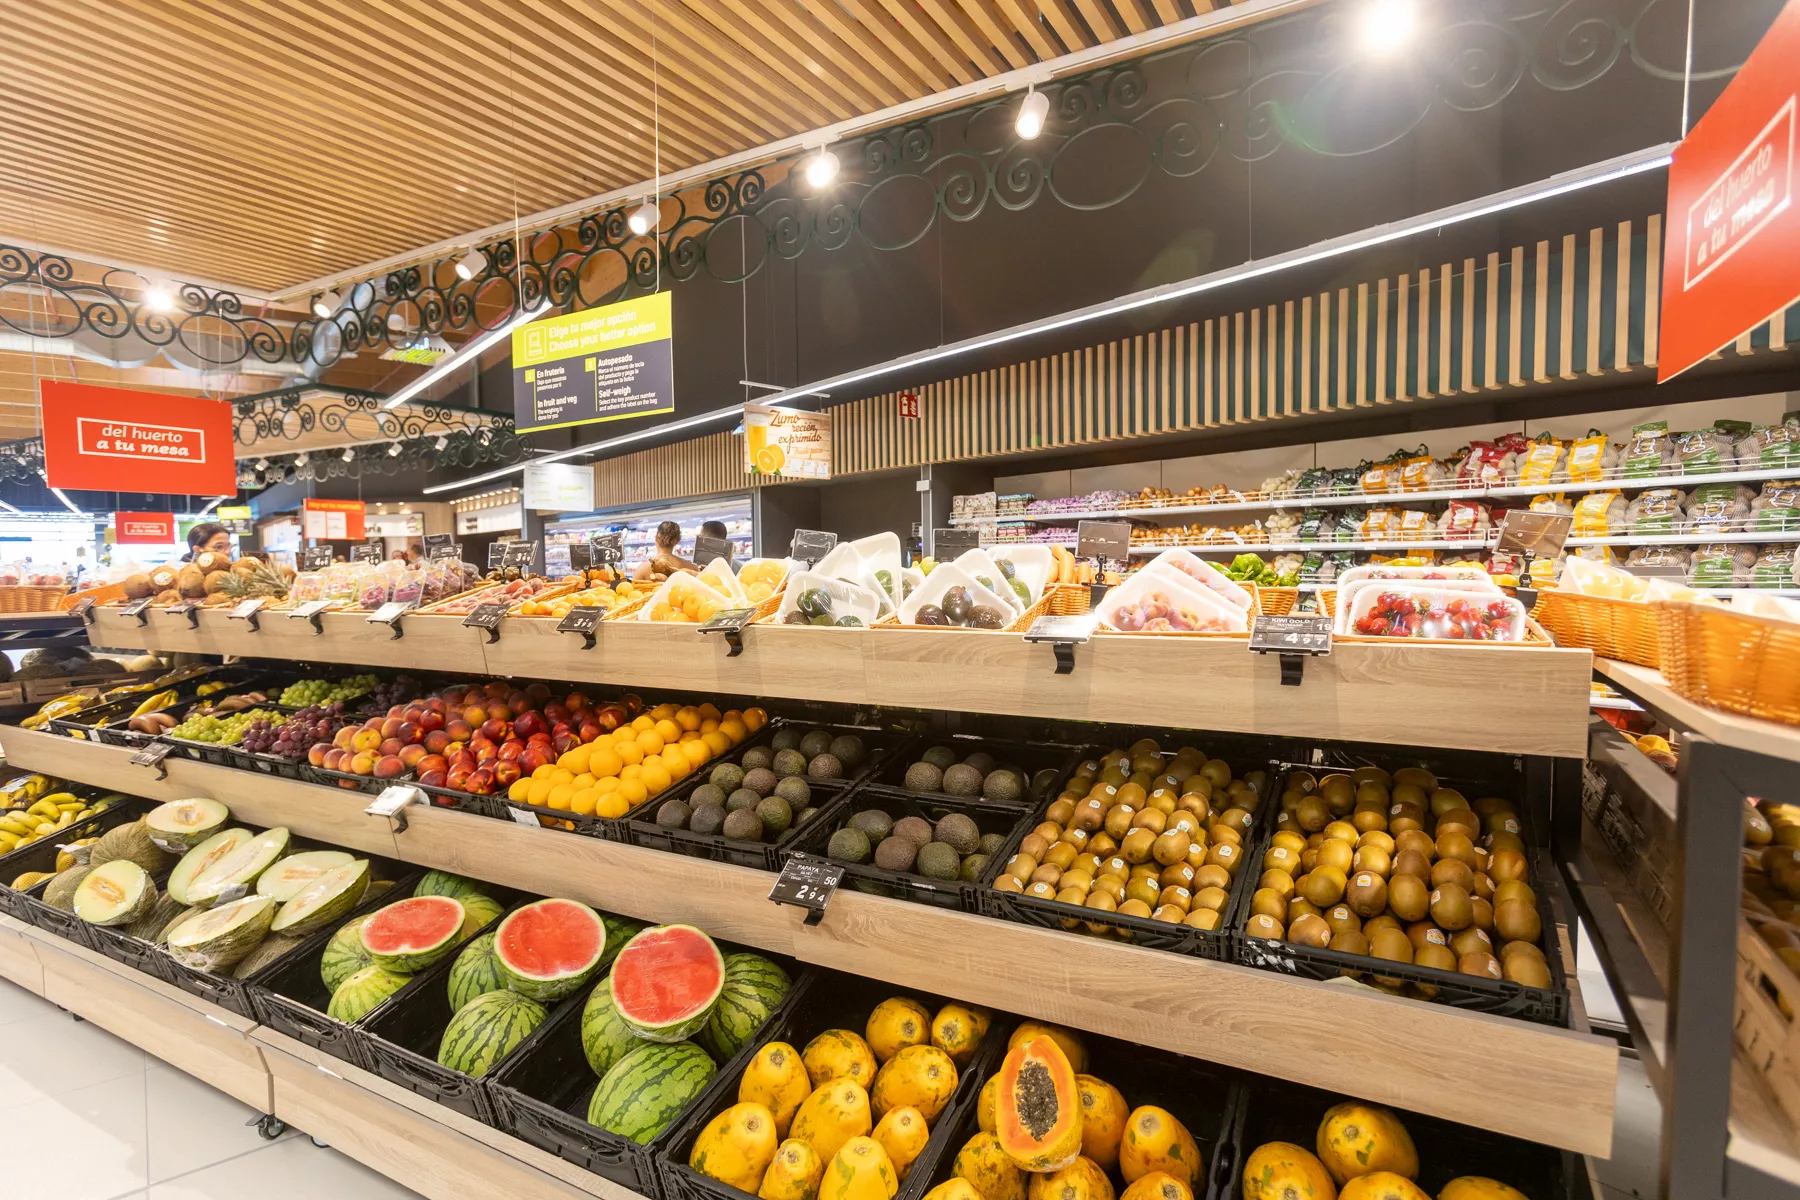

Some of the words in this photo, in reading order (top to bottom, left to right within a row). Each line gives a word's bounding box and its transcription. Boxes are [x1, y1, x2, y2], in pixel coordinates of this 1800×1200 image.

[1703, 183, 1725, 228] del
[1726, 143, 1773, 209] huerto
[1697, 240, 1708, 266] a
[1711, 223, 1727, 255] tu
[1731, 177, 1775, 237] mesa
[549, 326, 569, 339] Elige
[570, 324, 578, 334] tu
[581, 317, 605, 332] mejor
[607, 310, 637, 327] opción
[549, 338, 578, 353] Choose
[580, 335, 599, 348] your
[600, 329, 626, 343] better
[628, 322, 657, 337] option
[598, 354, 633, 368] Autopesado
[536, 370, 544, 379] En
[599, 385, 632, 398] Self-weigh
[640, 391, 656, 399] number
[537, 400, 543, 408] In
[544, 398, 556, 407] fruit
[556, 396, 567, 405] and
[567, 395, 578, 405] veg
[770, 409, 800, 427] Zumo
[102, 424, 127, 438] del
[132, 426, 183, 443] huerto
[792, 422, 818, 434] recién
[96, 440, 109, 450] a
[115, 439, 135, 452] tu
[140, 443, 190, 456] mesa
[778, 431, 822, 454] exprimido
[797, 864, 819, 873] PAPAYA
[823, 876, 837, 886] 50
